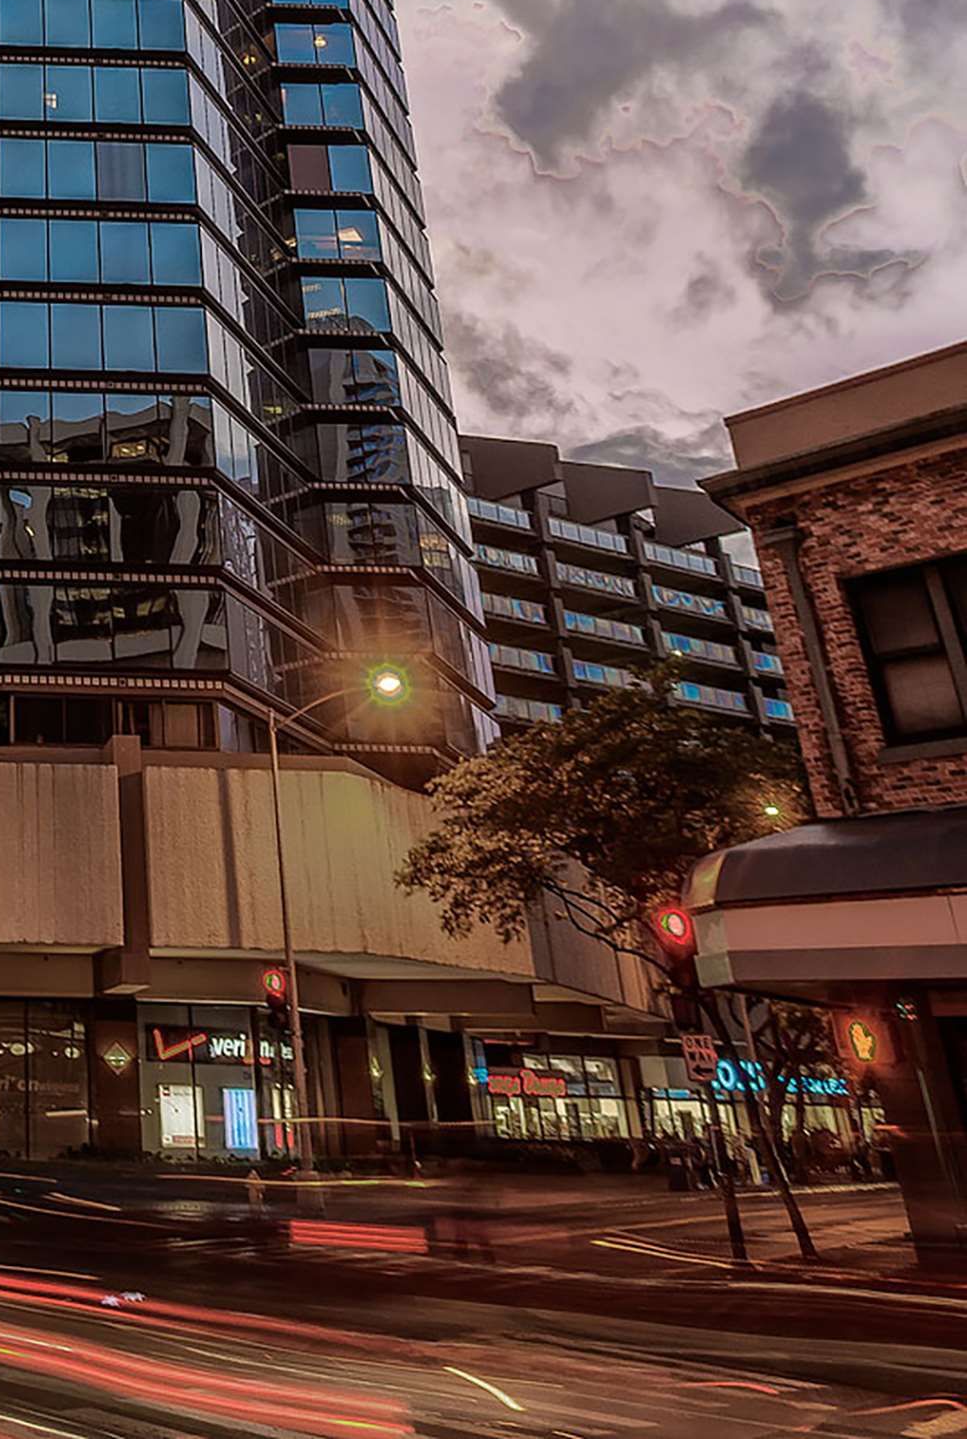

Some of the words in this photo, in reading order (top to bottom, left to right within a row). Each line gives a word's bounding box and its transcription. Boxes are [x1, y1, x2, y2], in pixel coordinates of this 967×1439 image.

[210, 1034, 271, 1062] verin
[684, 1036, 712, 1050] ONE
[687, 1050, 714, 1064] WAY
